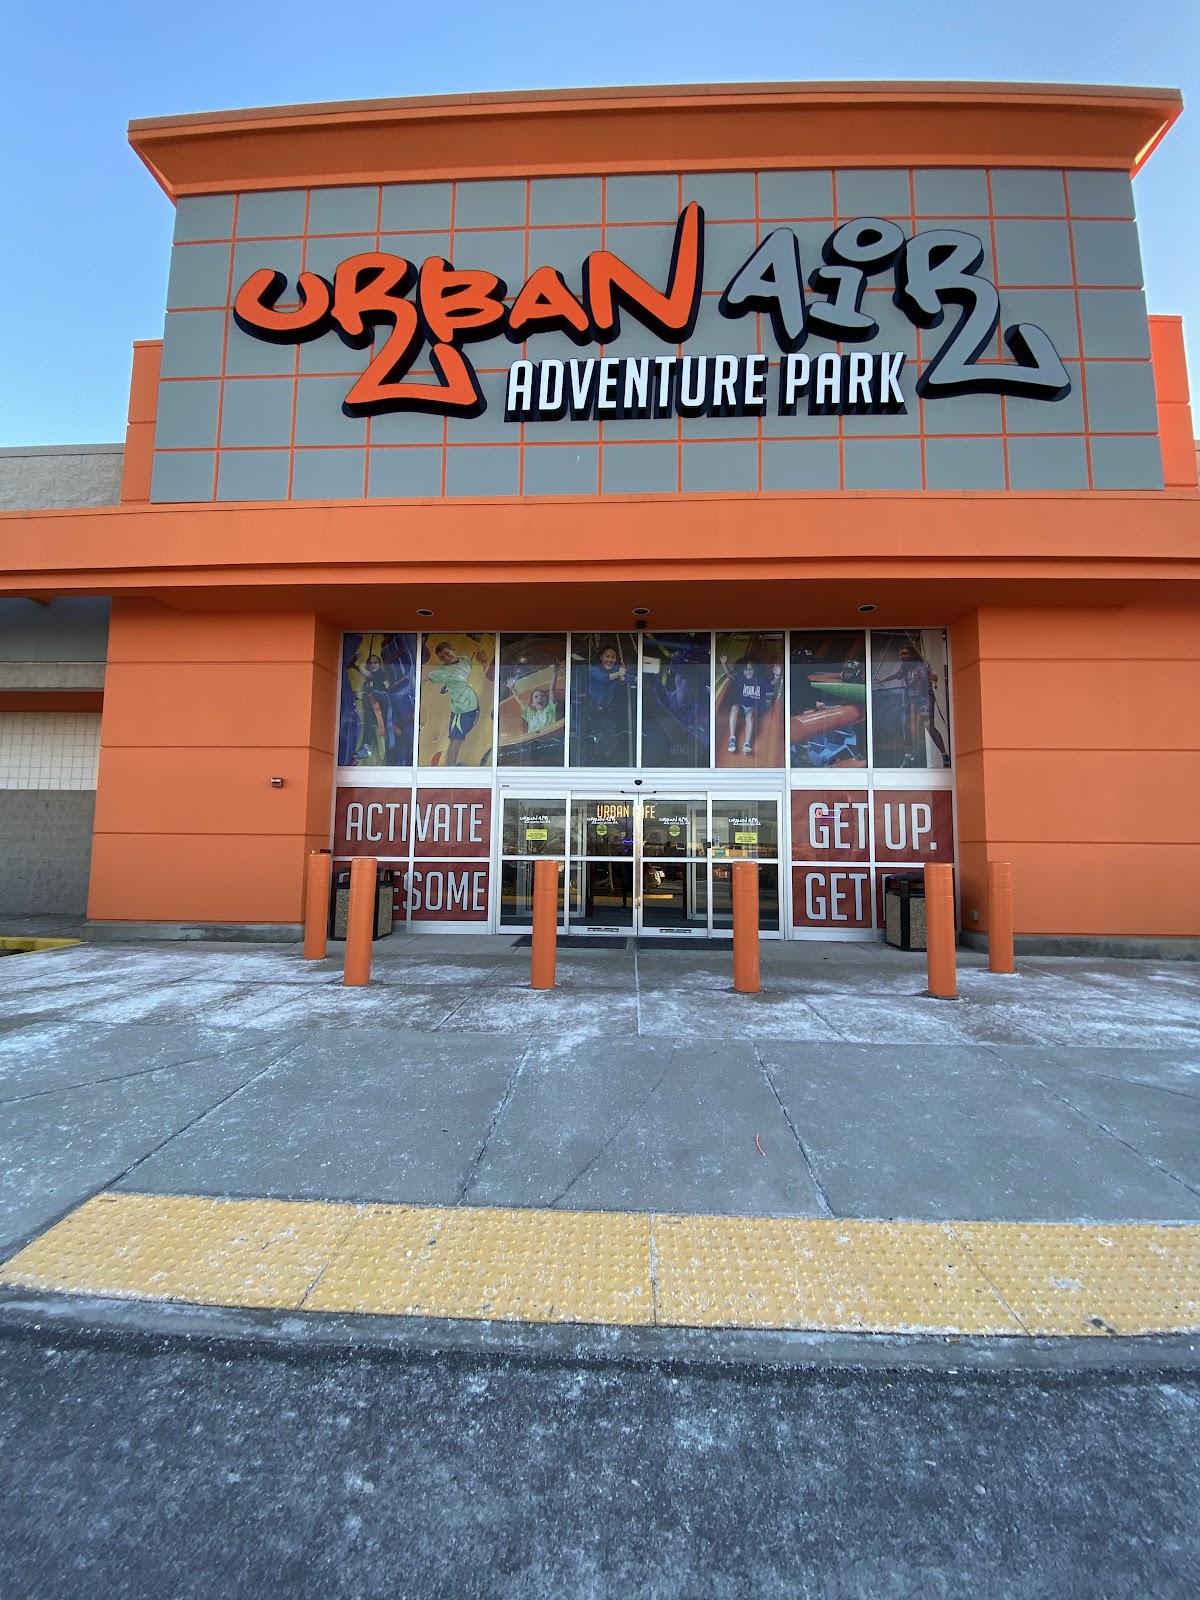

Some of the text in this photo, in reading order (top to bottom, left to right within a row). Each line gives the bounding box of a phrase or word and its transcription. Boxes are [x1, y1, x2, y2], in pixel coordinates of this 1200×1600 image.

[234, 201, 702, 412] URBAN
[506, 351, 906, 413] ADVENTURE PARK
[345, 803, 485, 842] ACTIVATE
[596, 805, 630, 818] URBAN
[808, 802, 939, 851] GET UP.
[805, 872, 868, 921] GET
